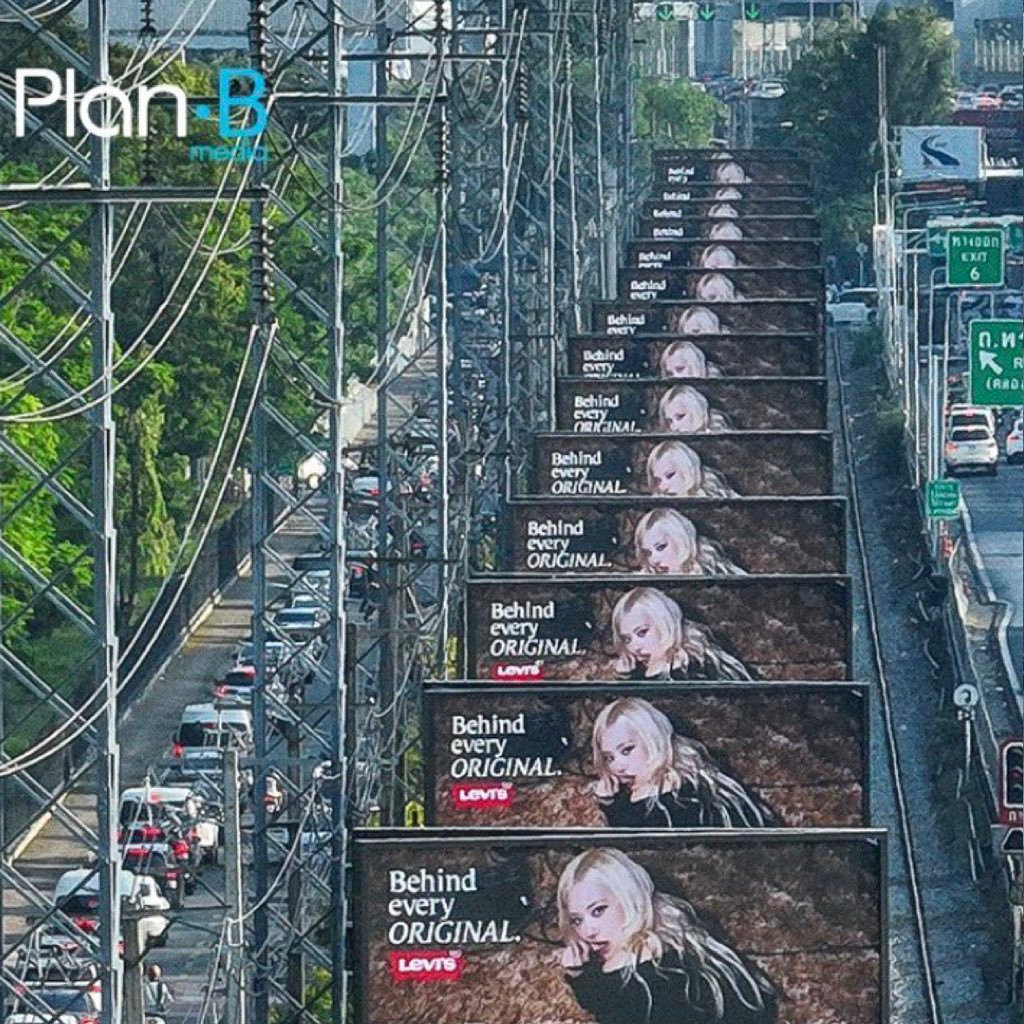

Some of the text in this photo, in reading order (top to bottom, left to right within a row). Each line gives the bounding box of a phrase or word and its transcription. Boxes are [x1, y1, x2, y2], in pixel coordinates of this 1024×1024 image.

[961, 251, 987, 262] EXIT
[970, 266, 980, 281] 6
[574, 395, 620, 408] Behind
[574, 408, 609, 421] every
[551, 451, 602, 466] Behind
[551, 466, 590, 482] every
[527, 520, 584, 536] Behind
[527, 538, 570, 556] every
[527, 553, 613, 569] ORIGINAL.
[490, 600, 555, 619] Behind
[490, 622, 539, 641] every
[490, 638, 587, 657] ORIGINAL.
[452, 714, 525, 735] Behind
[451, 736, 507, 758] every
[451, 757, 563, 779] ORIGINAL.
[389, 868, 478, 892] Behind
[388, 897, 455, 921] every
[388, 920, 522, 945] ORIGINAL.
